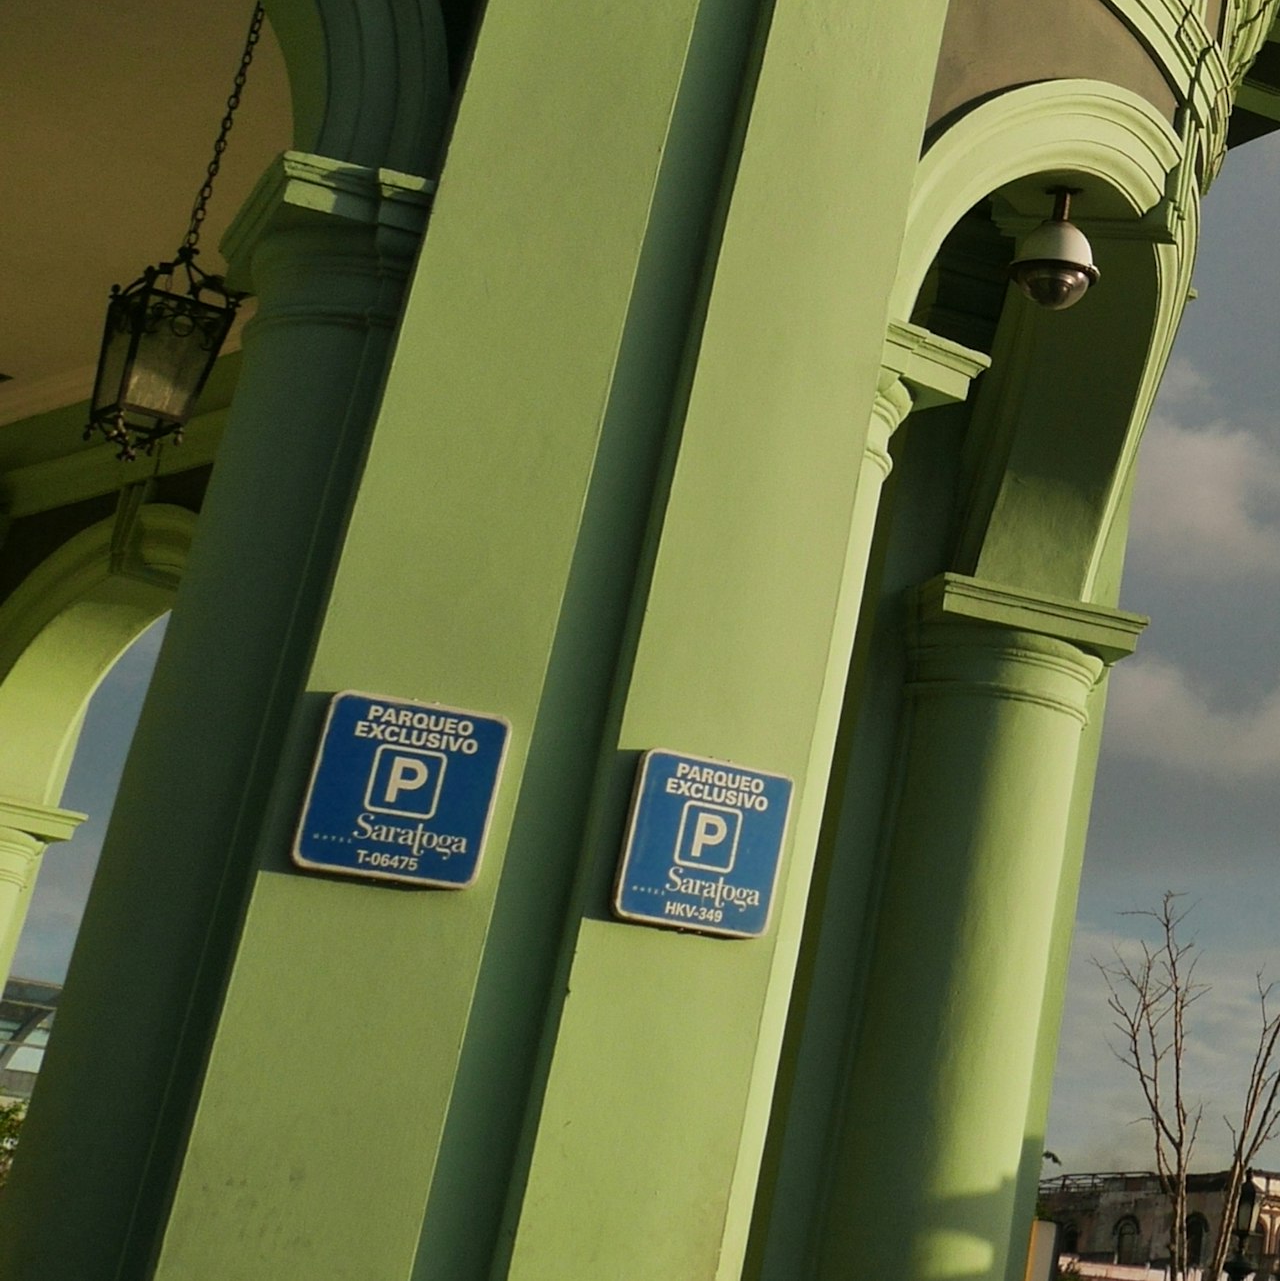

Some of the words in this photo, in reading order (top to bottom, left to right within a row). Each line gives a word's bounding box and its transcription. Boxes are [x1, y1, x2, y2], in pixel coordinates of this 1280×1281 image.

[367, 705, 474, 736] PARQUEO
[354, 721, 478, 755] EXCLUSIVO
[384, 756, 428, 803] P
[665, 778, 768, 812] EXCLUSIVO
[676, 762, 764, 794] PARQUEO
[353, 813, 467, 860] Saratoga
[691, 812, 727, 857] P
[356, 850, 418, 871] T-06475
[665, 866, 760, 912] Saratoga
[665, 901, 723, 923] HKV-349
